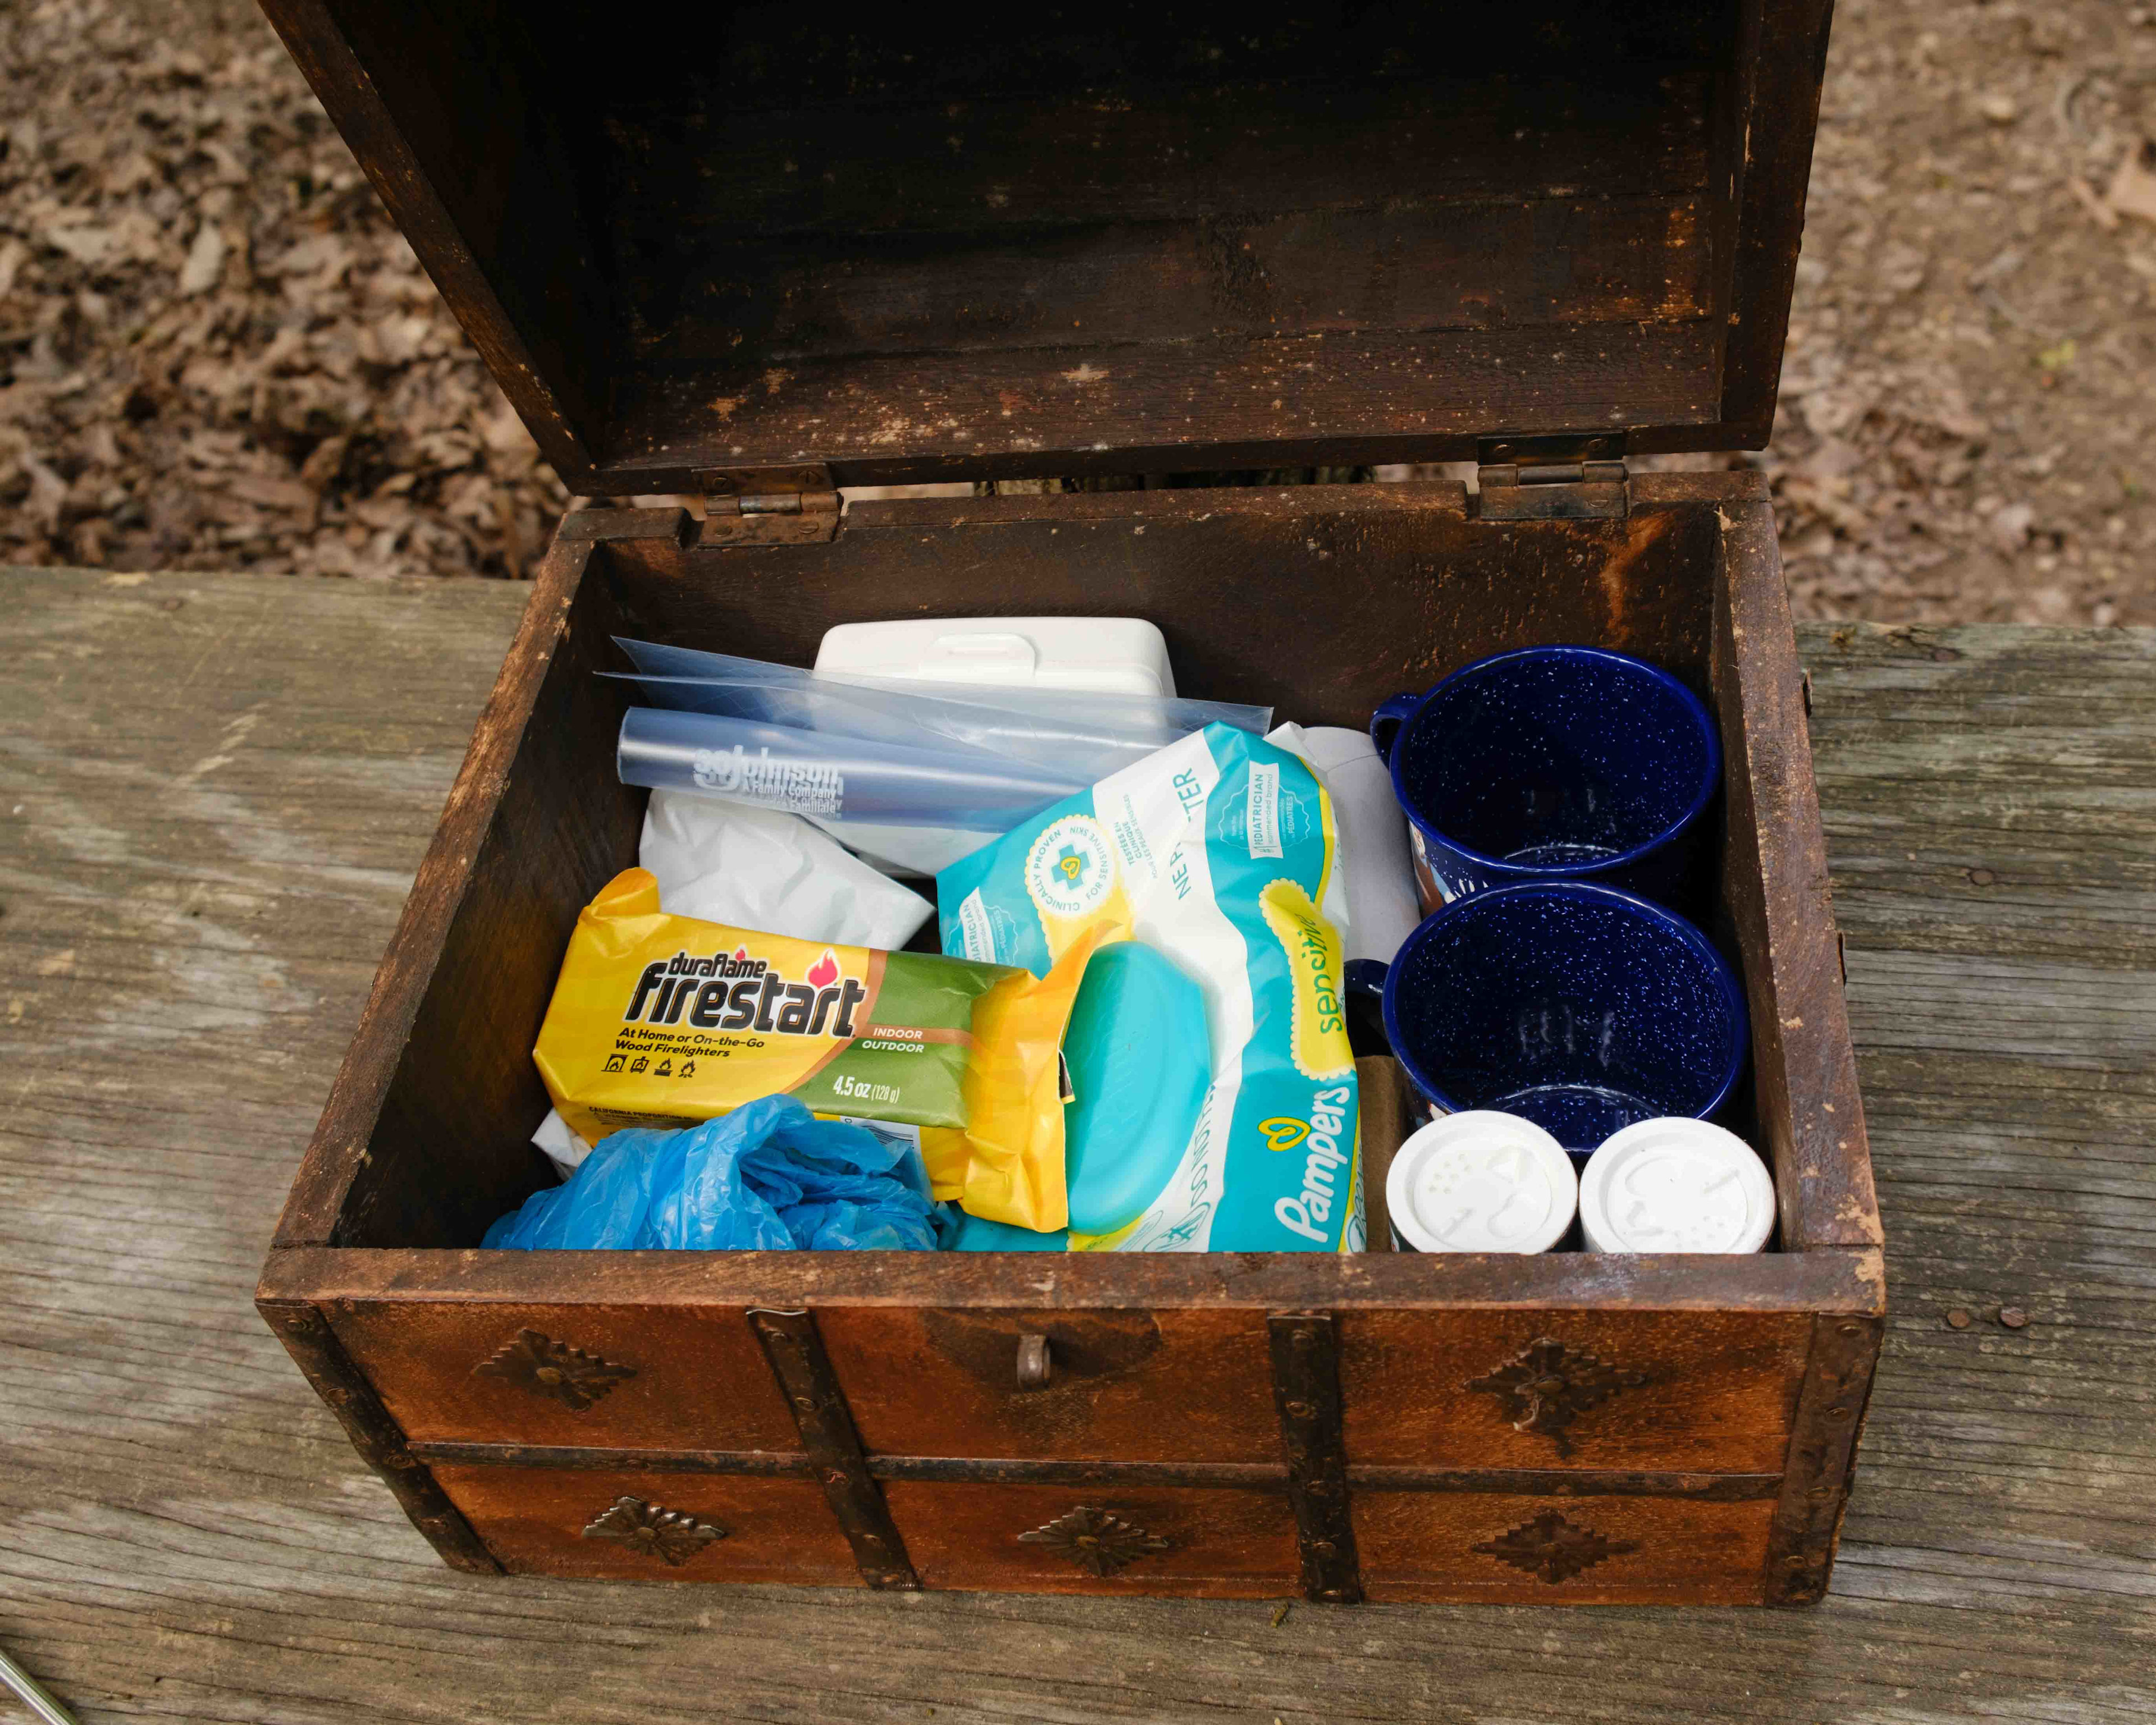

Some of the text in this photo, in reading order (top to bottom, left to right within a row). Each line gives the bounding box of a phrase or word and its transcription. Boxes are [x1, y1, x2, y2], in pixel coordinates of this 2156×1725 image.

[752, 784, 786, 798] Family
[788, 786, 837, 800] Company
[1252, 774, 1264, 845] PEDIATRICIAN
[1114, 822, 1122, 832] EN
[1123, 822, 1143, 859] CLINIQUE
[1034, 829, 1080, 911] CLINICALLY PROVEN
[1070, 826, 1108, 900] FOR SENSITIVE SKIN
[668, 952, 768, 978] duraflame
[624, 962, 865, 1038] firestart
[619, 1027, 765, 1048] At Home or On-the-Go
[873, 1028, 923, 1039] INDOOR
[615, 1039, 730, 1057] Wood Firelighters
[862, 1041, 924, 1053] OUTDOOR
[833, 1075, 901, 1104] 4.5 oz (128 g)
[589, 1106, 633, 1116] CALIFORNIA
[1275, 1087, 1350, 1243] Pampers
